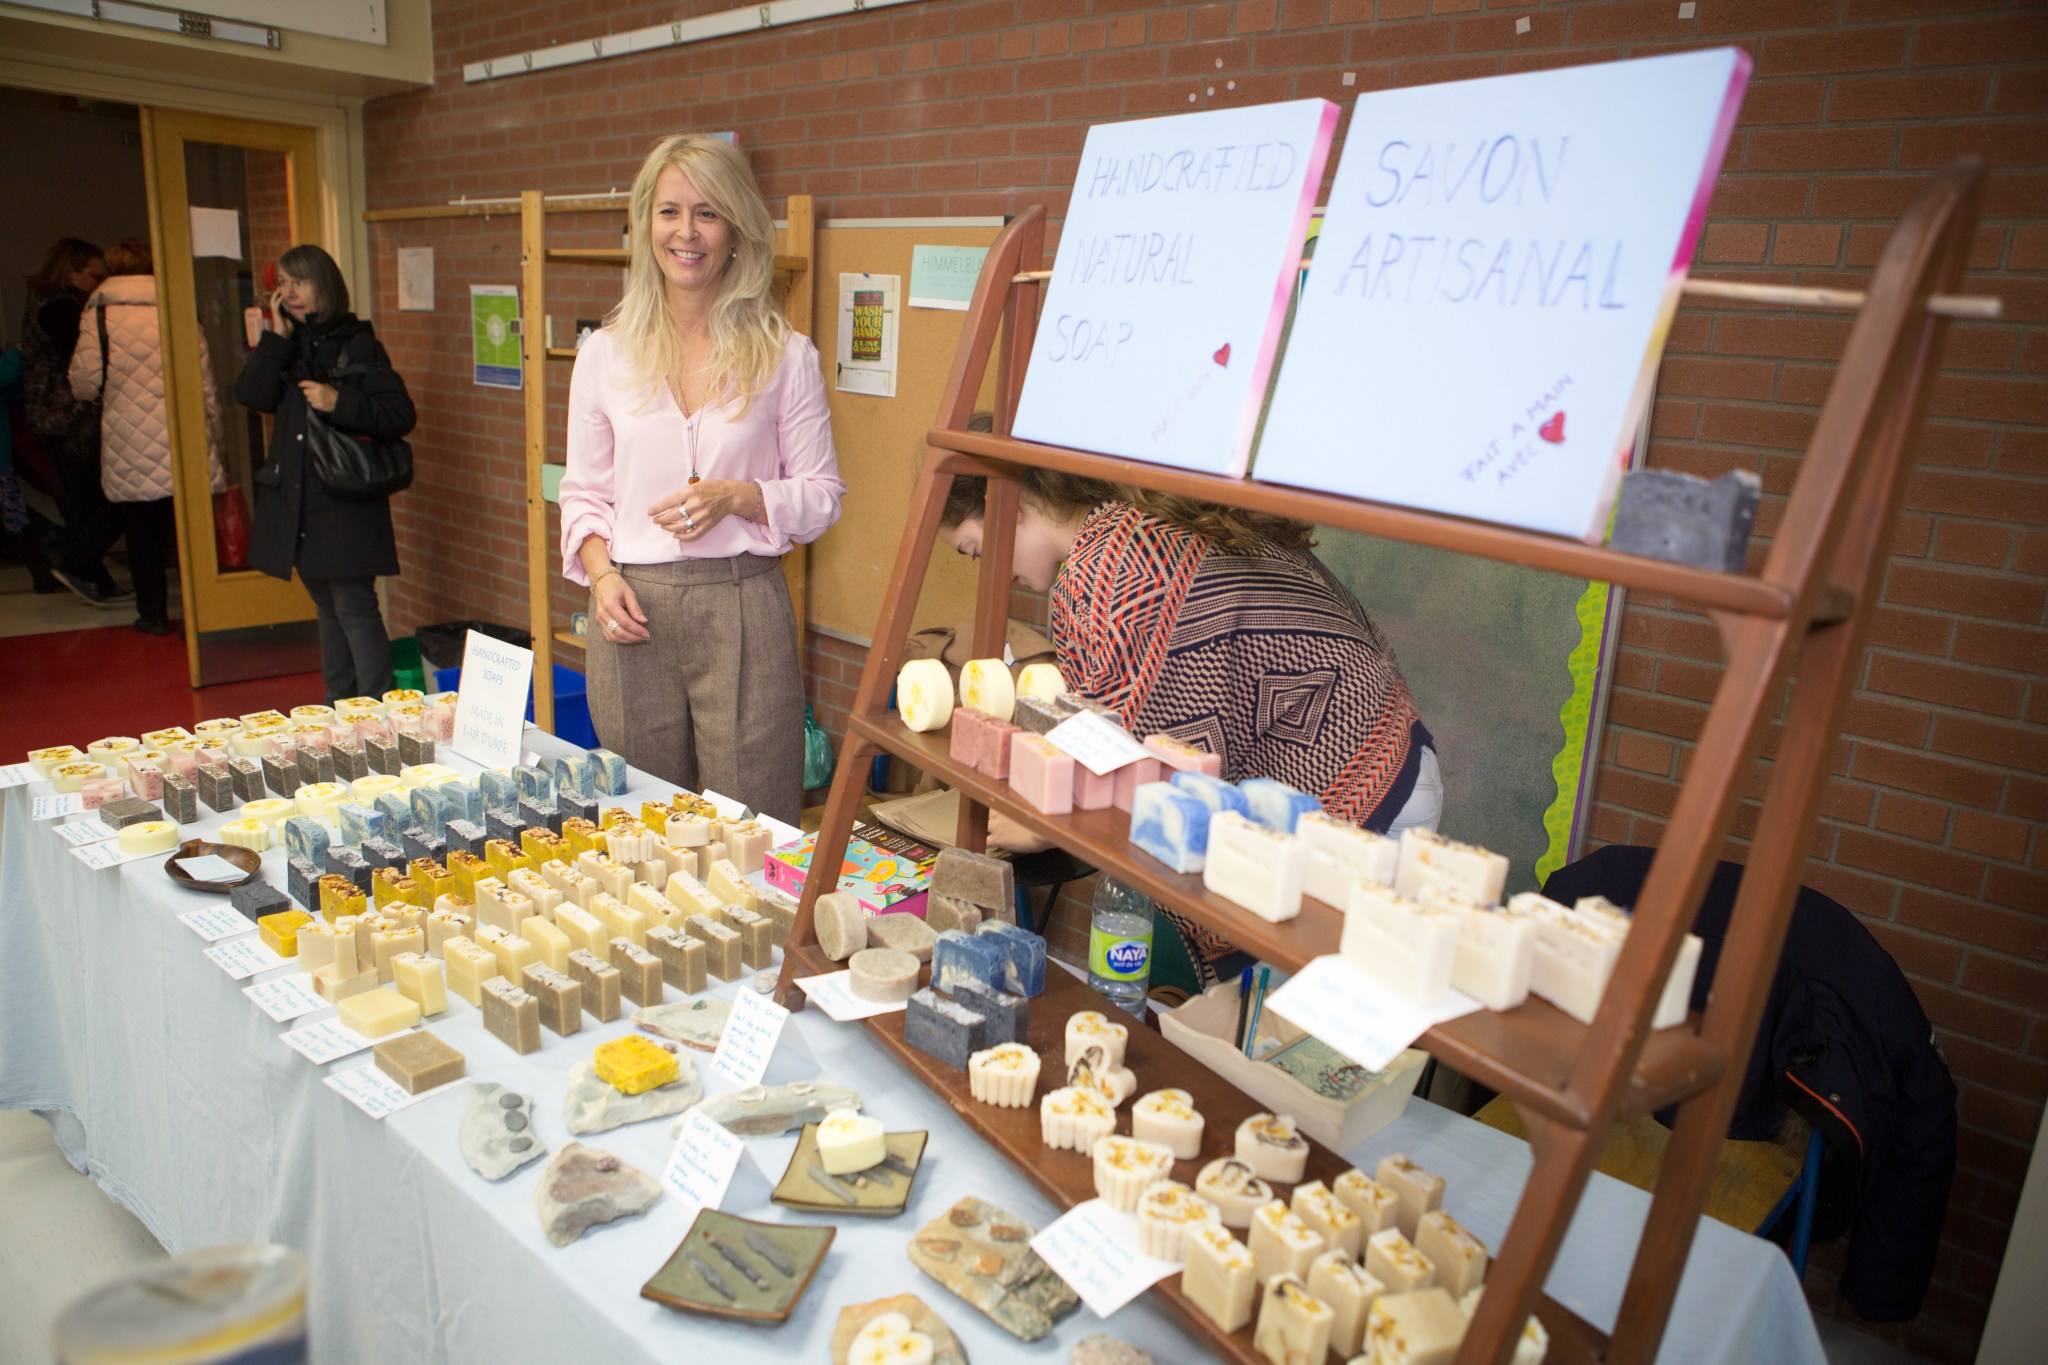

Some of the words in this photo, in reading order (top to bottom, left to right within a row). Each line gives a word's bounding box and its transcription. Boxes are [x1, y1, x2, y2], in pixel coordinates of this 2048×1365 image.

[1088, 141, 1297, 200] HANDCRAFTED
[1365, 134, 1570, 208] SAVON
[1069, 231, 1194, 287] NATURAL
[1333, 232, 1631, 312] ARTISANAL
[854, 305, 883, 317] WASH
[854, 316, 881, 328] YOUR
[853, 327, 881, 338] HANDS
[1048, 314, 1134, 367] SOAP
[1525, 373, 1575, 421] MAIN
[471, 644, 521, 671] HANDCRAFTED
[482, 668, 504, 686] SOAPS
[470, 704, 493, 725] MADE
[494, 714, 505, 728] IN
[1110, 947, 1147, 961] NAYA
